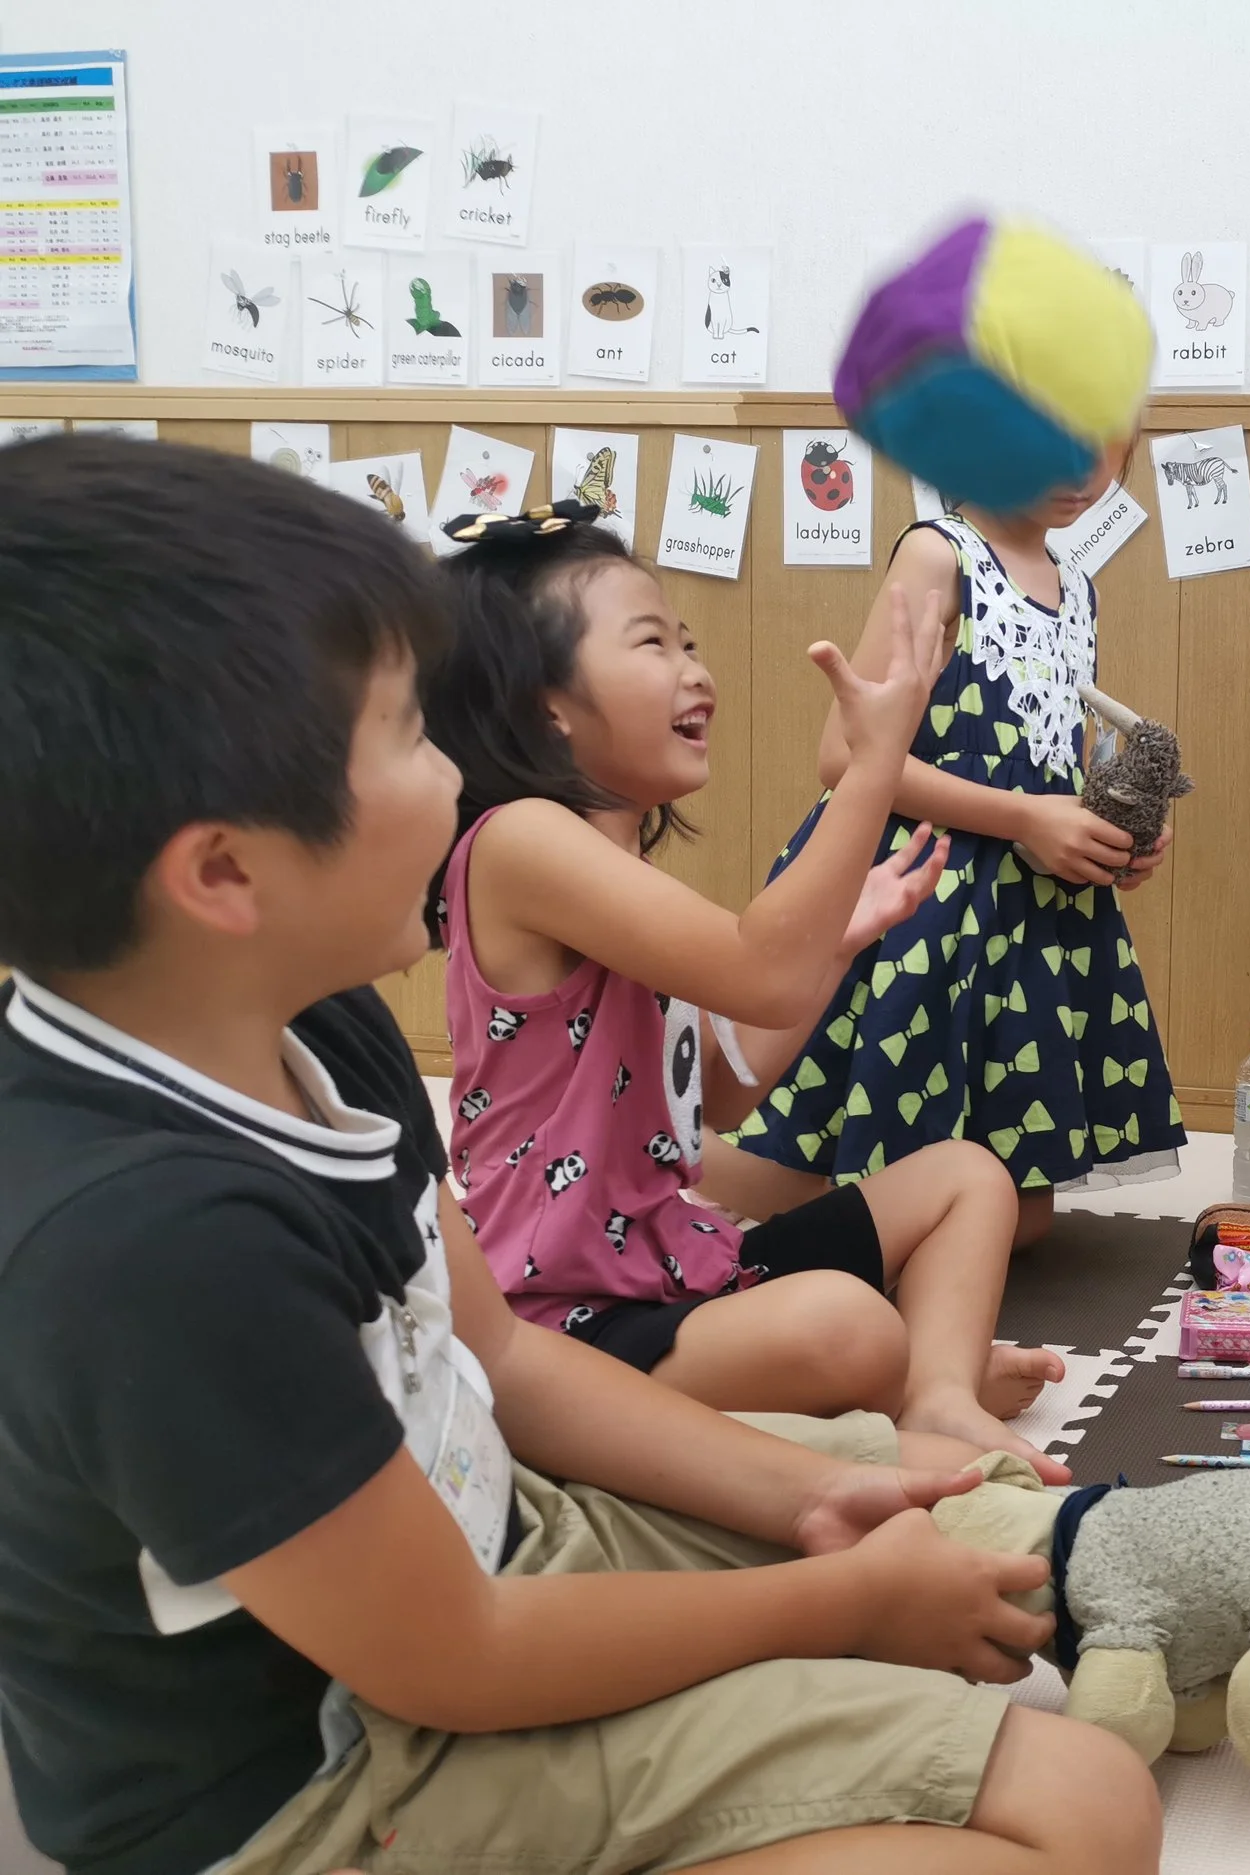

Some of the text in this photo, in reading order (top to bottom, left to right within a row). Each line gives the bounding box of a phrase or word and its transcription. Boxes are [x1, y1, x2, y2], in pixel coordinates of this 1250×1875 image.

[365, 205, 410, 229] firefly
[460, 207, 511, 225] cricket
[265, 228, 330, 248] stag beetle
[212, 342, 273, 363] mosquito
[391, 351, 462, 368] green caterpillar
[492, 351, 544, 367] cicada
[597, 348, 622, 360] ant
[711, 351, 736, 363] cat
[1173, 342, 1226, 359] rabbit
[317, 352, 364, 372] spider
[797, 523, 860, 544] ladybug
[1070, 503, 1128, 565] rhinoceros
[666, 538, 735, 560] grasshopper
[1186, 536, 1234, 555] zebra
